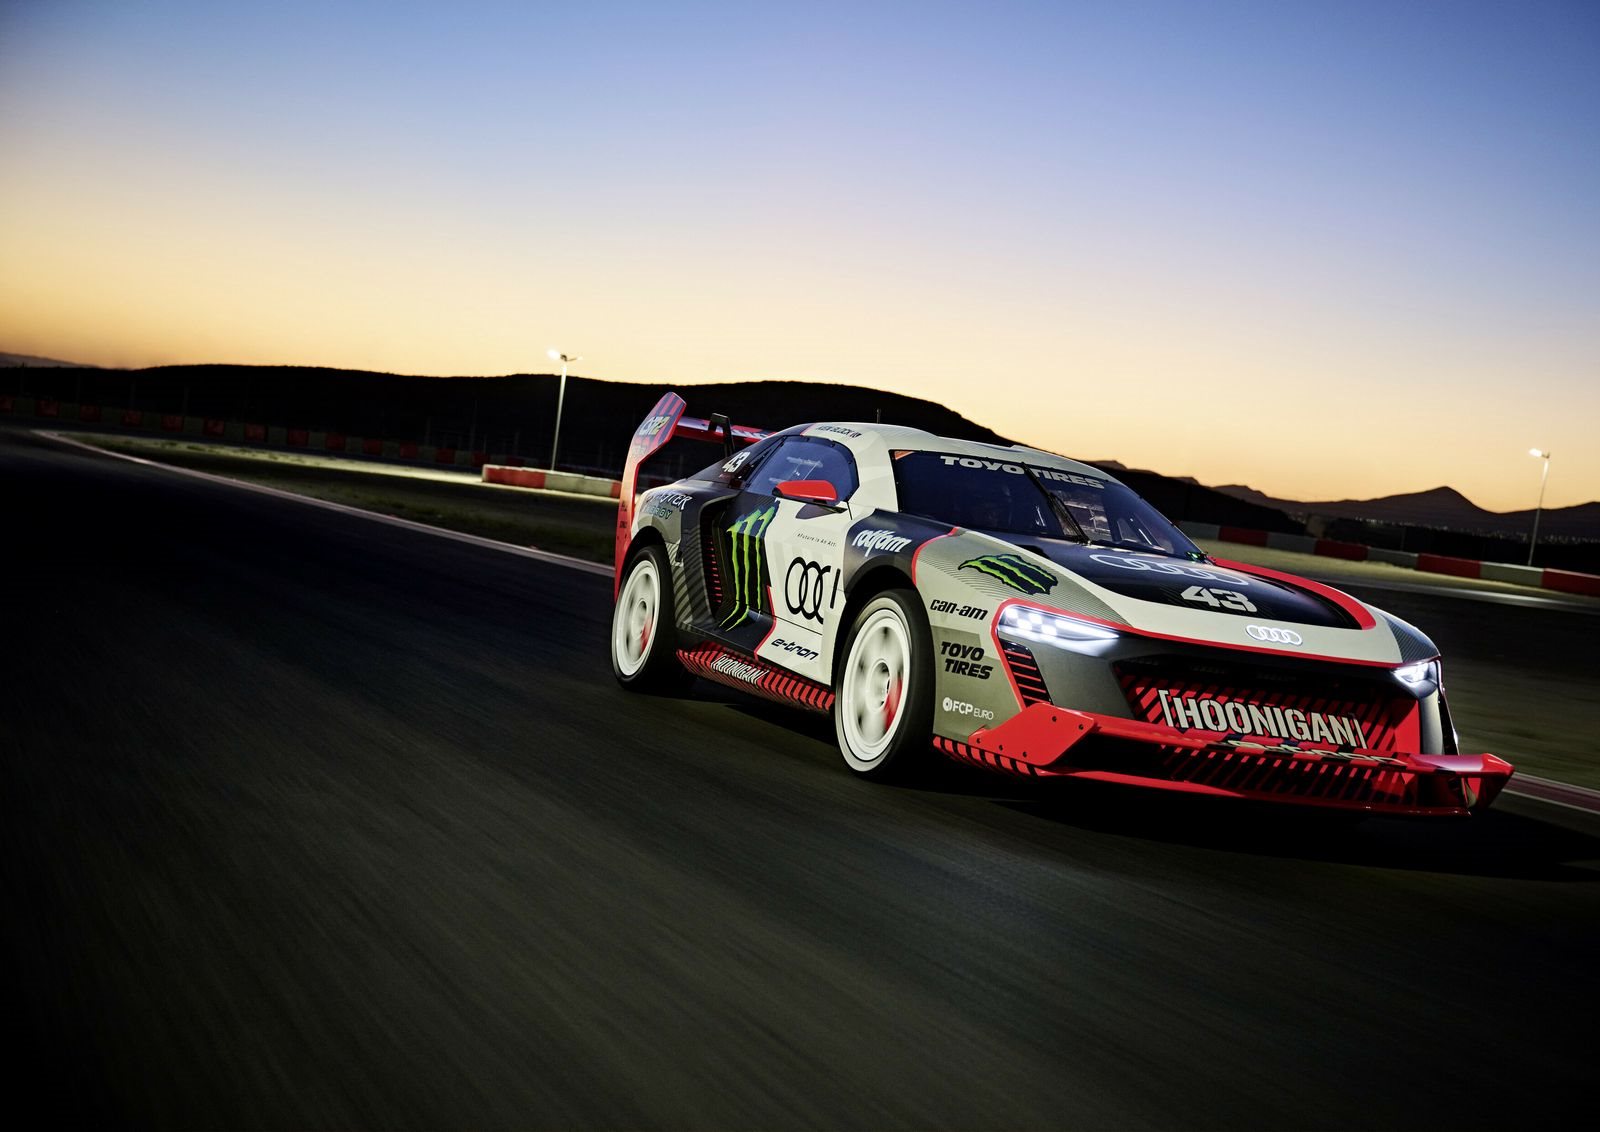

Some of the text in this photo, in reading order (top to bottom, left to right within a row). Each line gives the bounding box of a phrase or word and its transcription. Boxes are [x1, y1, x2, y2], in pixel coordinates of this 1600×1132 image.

[721, 451, 751, 473] 43
[940, 455, 1105, 489] TOYO TIRES
[1180, 585, 1258, 612] 43
[930, 599, 989, 621] can-am
[771, 638, 819, 661] e-tron
[940, 641, 985, 662] TOYO
[944, 658, 994, 680] TIRES
[952, 700, 994, 721] FCP EURO
